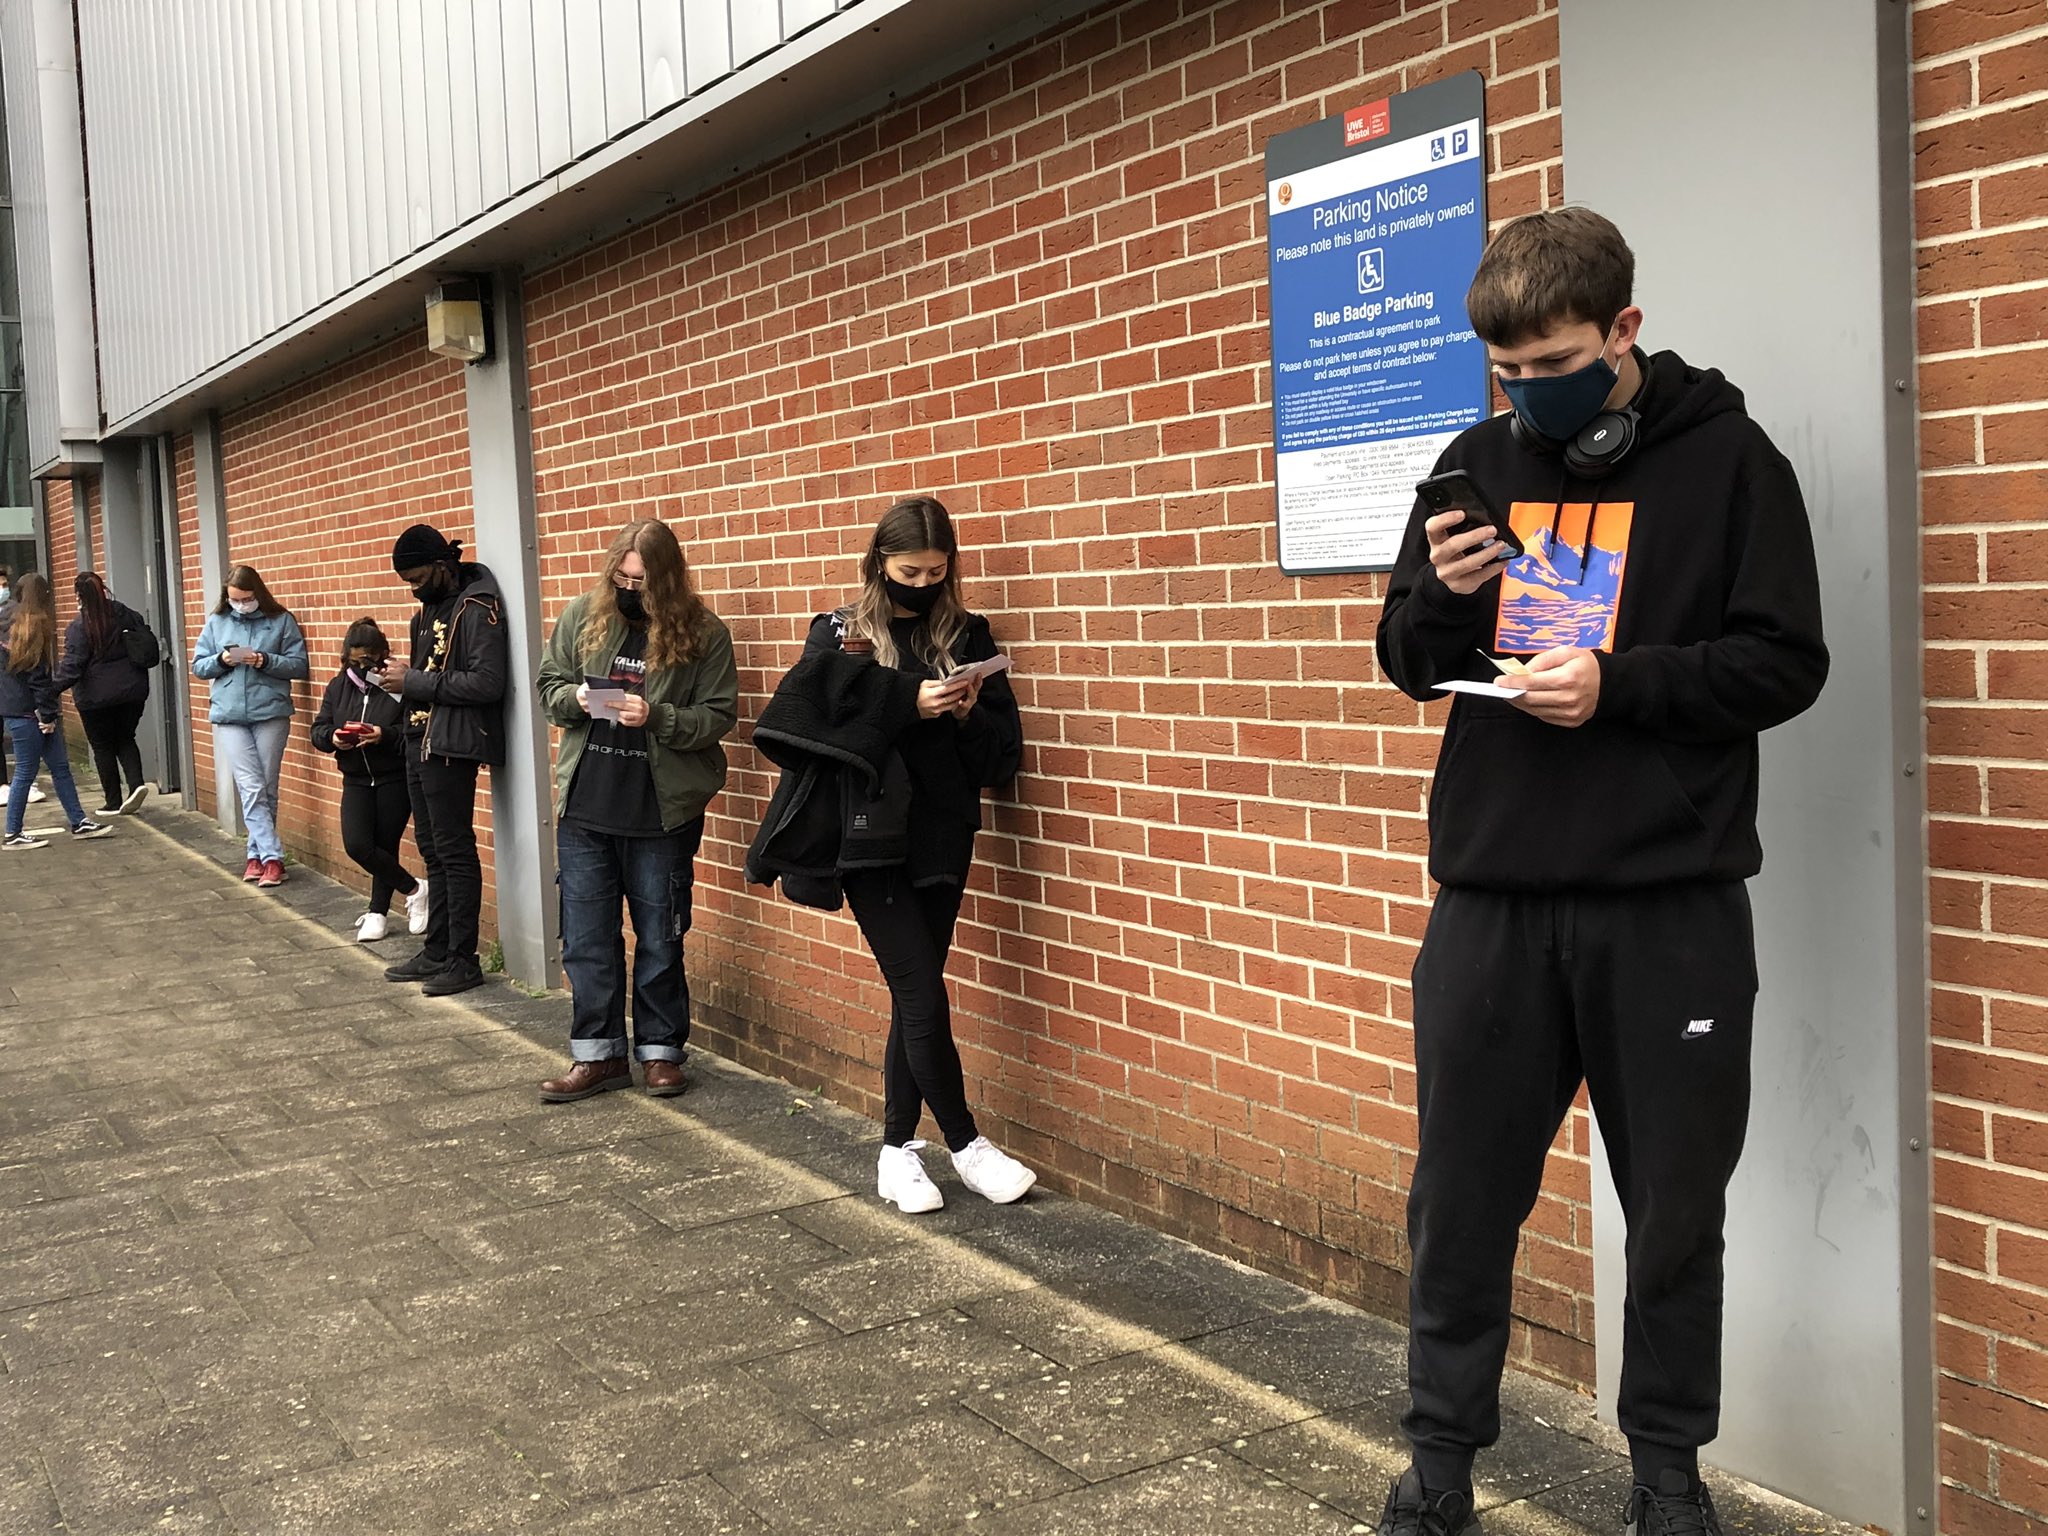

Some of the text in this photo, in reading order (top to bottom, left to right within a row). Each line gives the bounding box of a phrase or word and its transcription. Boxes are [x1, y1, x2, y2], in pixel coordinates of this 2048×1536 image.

[1346, 118, 1364, 132] UWE
[1347, 126, 1370, 142] Bristol
[1314, 183, 1428, 230] Parking Notice
[1277, 198, 1474, 262] Please note this land is privately owned
[1314, 291, 1433, 328] Blue Badge Parking
[1309, 338, 1323, 348] This
[1324, 336, 1330, 346] is
[1338, 327, 1374, 343] contractual
[1376, 320, 1414, 338] agreement
[1415, 319, 1422, 328] to
[1424, 314, 1440, 329] park
[1280, 330, 1477, 372] Please do not park here unless you agree to pay charges
[1314, 352, 1437, 380] and accept terms of contract below:
[1687, 1019, 1714, 1033] NIKE
